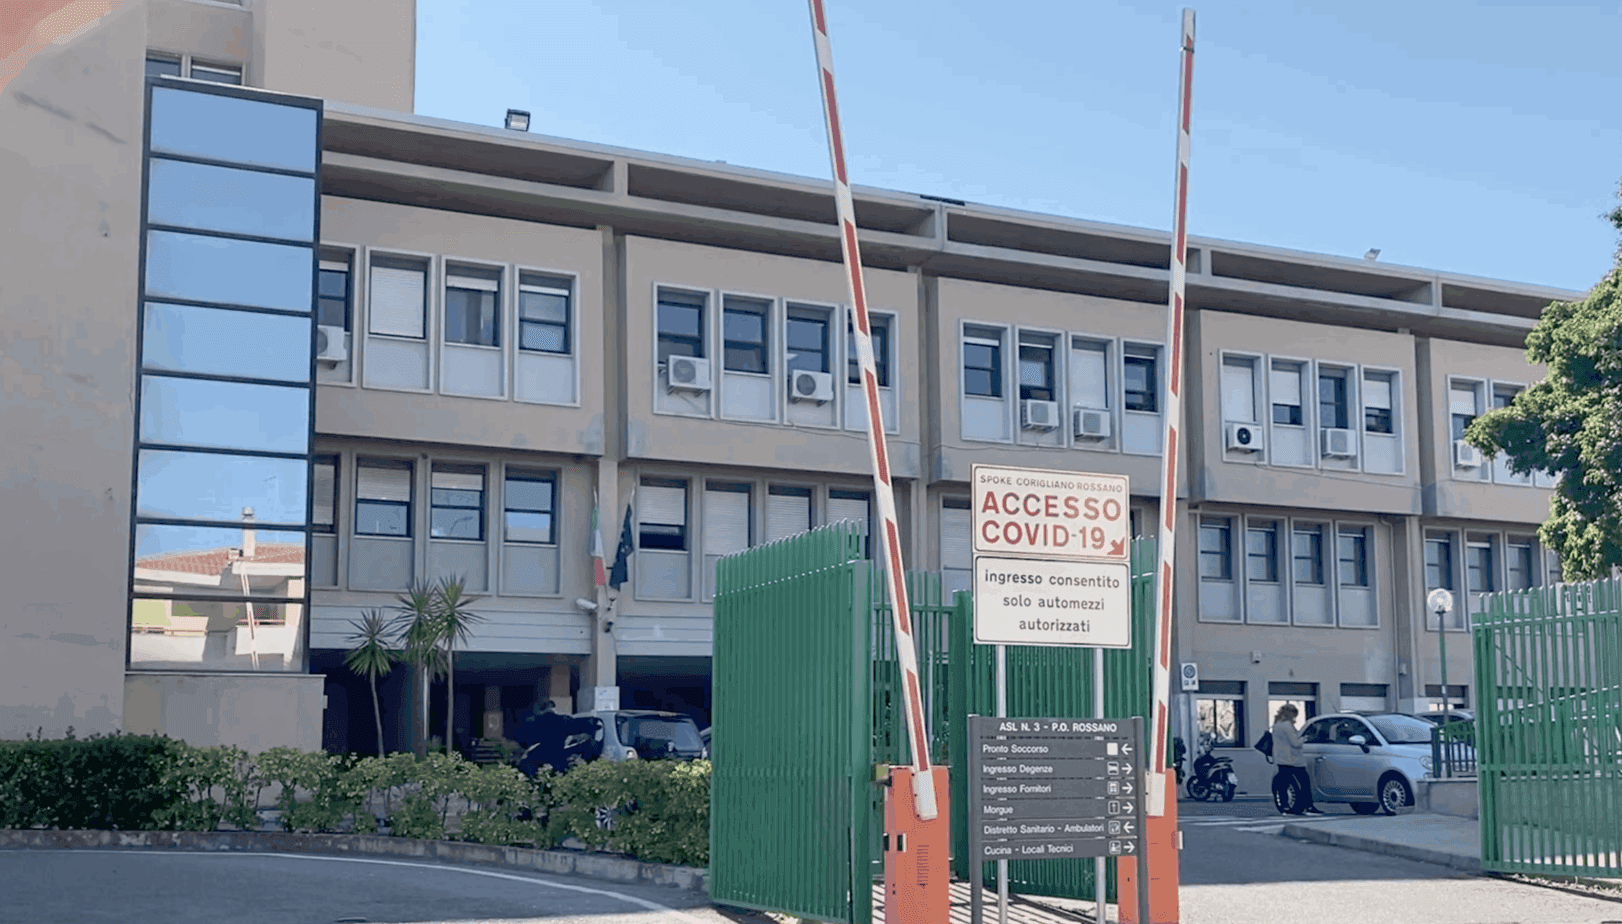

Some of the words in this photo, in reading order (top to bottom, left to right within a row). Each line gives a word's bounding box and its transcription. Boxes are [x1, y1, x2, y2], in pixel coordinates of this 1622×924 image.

[980, 475, 1012, 485] SPOKE
[1017, 478, 1074, 490] CORIGLIANO
[1077, 482, 1122, 493] ROSSANO
[982, 491, 1121, 521] ACCESSO
[982, 520, 1105, 550] COVID-19
[985, 570, 1042, 585] ingresso
[1049, 575, 1119, 588] consentito
[1003, 594, 1031, 607] solo
[1038, 596, 1104, 610] automezzi
[1019, 619, 1090, 632] autorizzati
[999, 722, 1018, 731] ASL
[1021, 722, 1030, 731] N.
[1034, 722, 1040, 731] 3
[1052, 722, 1069, 732] P.O.
[1073, 723, 1117, 732] ROSSANO
[983, 745, 1008, 753] Pronto
[1011, 744, 1049, 753] Soccorso
[983, 765, 1017, 774] Ingresso
[1020, 765, 1053, 774] Degenze
[983, 785, 1017, 795] Ingresso
[1020, 785, 1051, 793] Fornitori
[984, 806, 1013, 814] Morgue
[984, 826, 1017, 834] Distretto
[1020, 825, 1055, 834] Sanitario
[1064, 824, 1104, 832] Ambulatori
[984, 846, 1011, 855] Cucina
[1022, 845, 1044, 854] Locali
[1048, 844, 1073, 853] Tecnici
